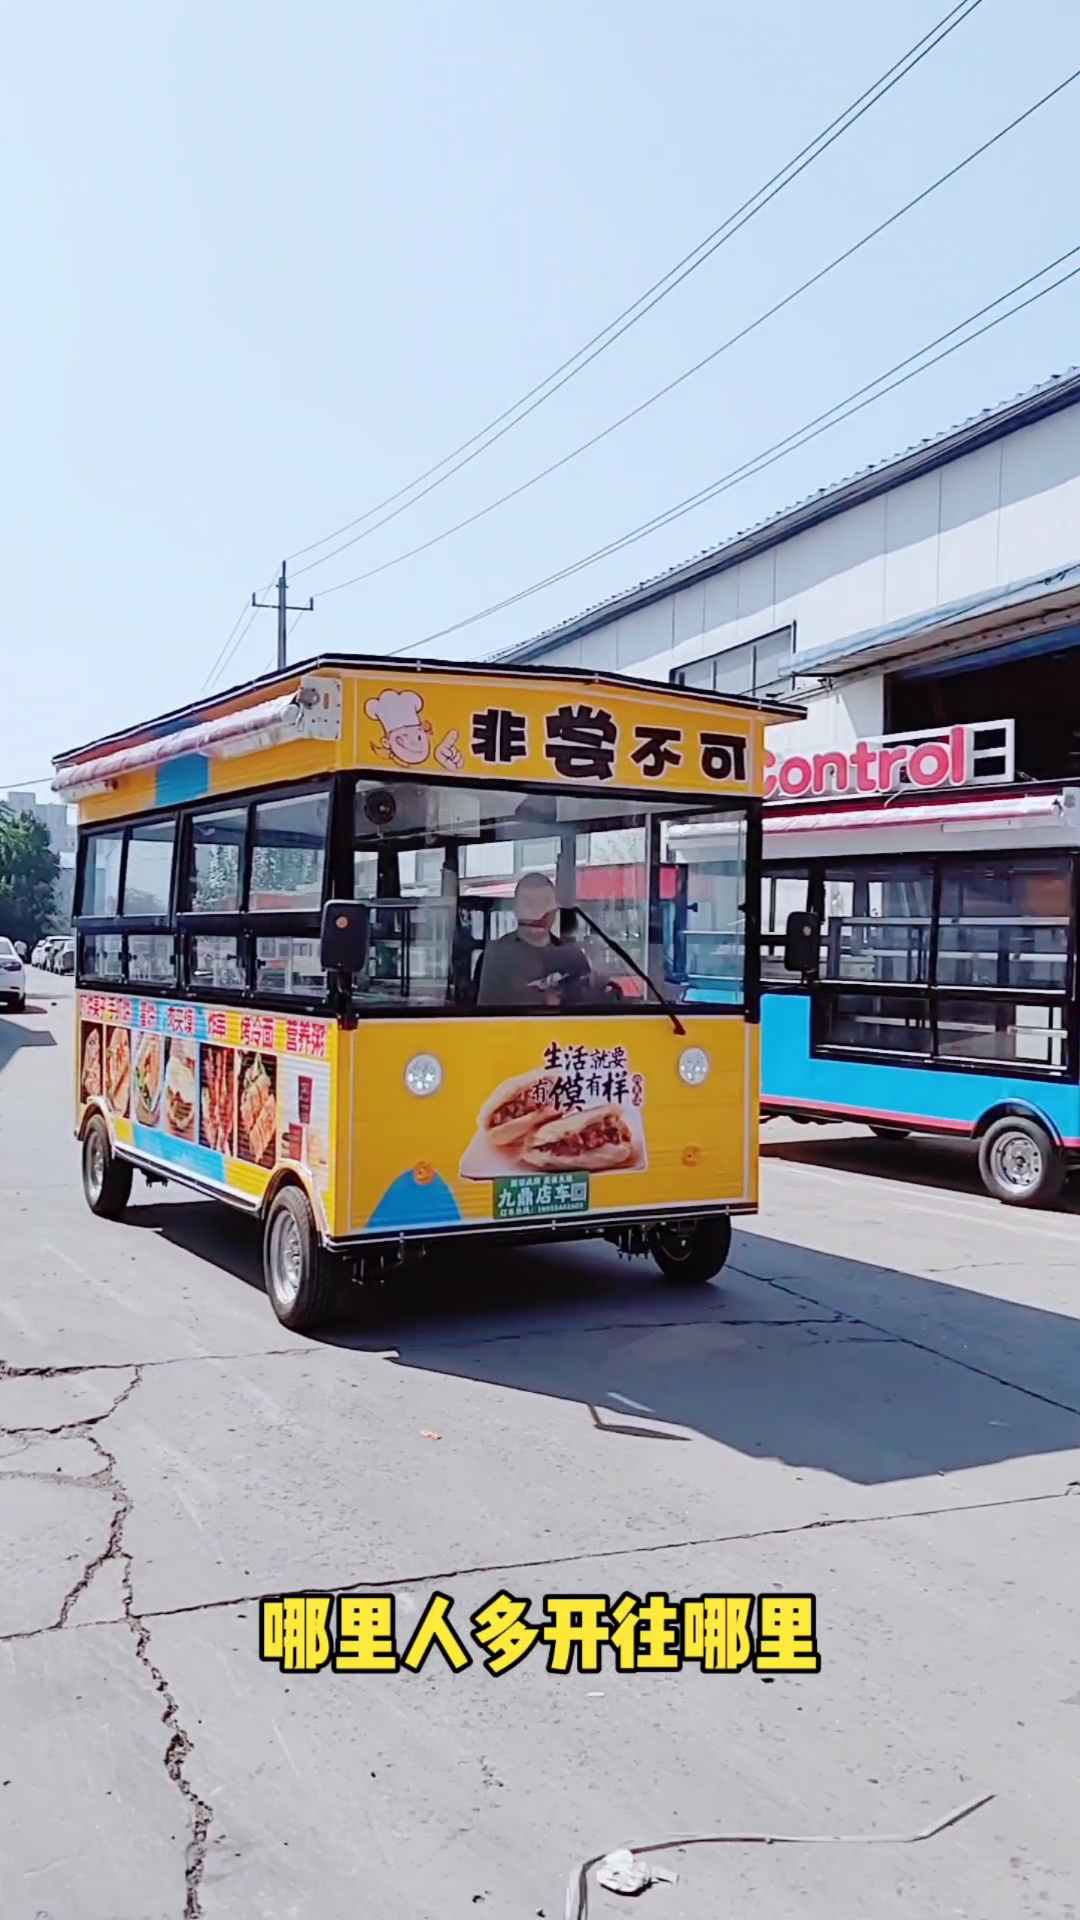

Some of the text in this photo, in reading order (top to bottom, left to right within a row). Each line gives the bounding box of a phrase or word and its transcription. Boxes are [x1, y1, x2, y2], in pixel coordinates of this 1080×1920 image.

[471, 704, 747, 781] 非尝不可
[241, 1016, 275, 1049] 烤冷面
[286, 1018, 326, 1057] 营养粥
[544, 1041, 628, 1071] 生活就要
[531, 1071, 630, 1112] 有馍有样
[497, 1184, 572, 1208] 九鼎店车
